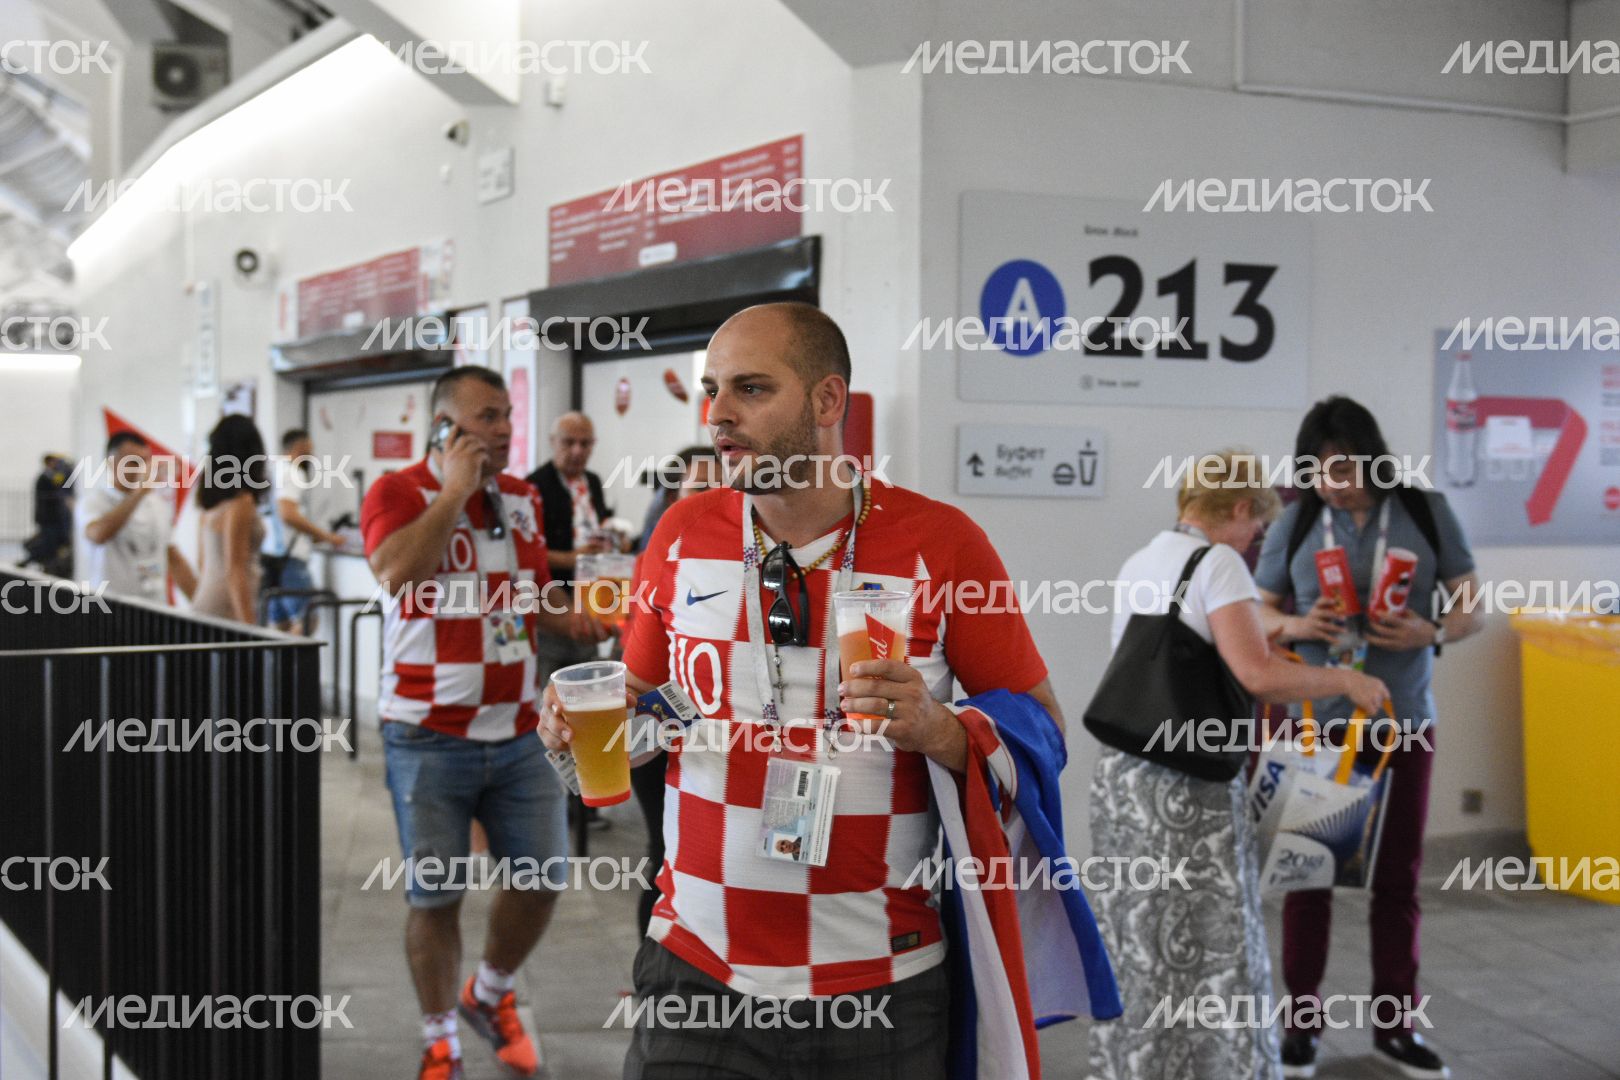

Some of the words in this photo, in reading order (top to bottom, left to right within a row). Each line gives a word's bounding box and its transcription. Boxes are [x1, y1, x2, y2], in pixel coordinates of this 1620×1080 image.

[1083, 254, 1279, 363] 213
[996, 444, 1047, 462] Буфет
[677, 637, 723, 716] 10
